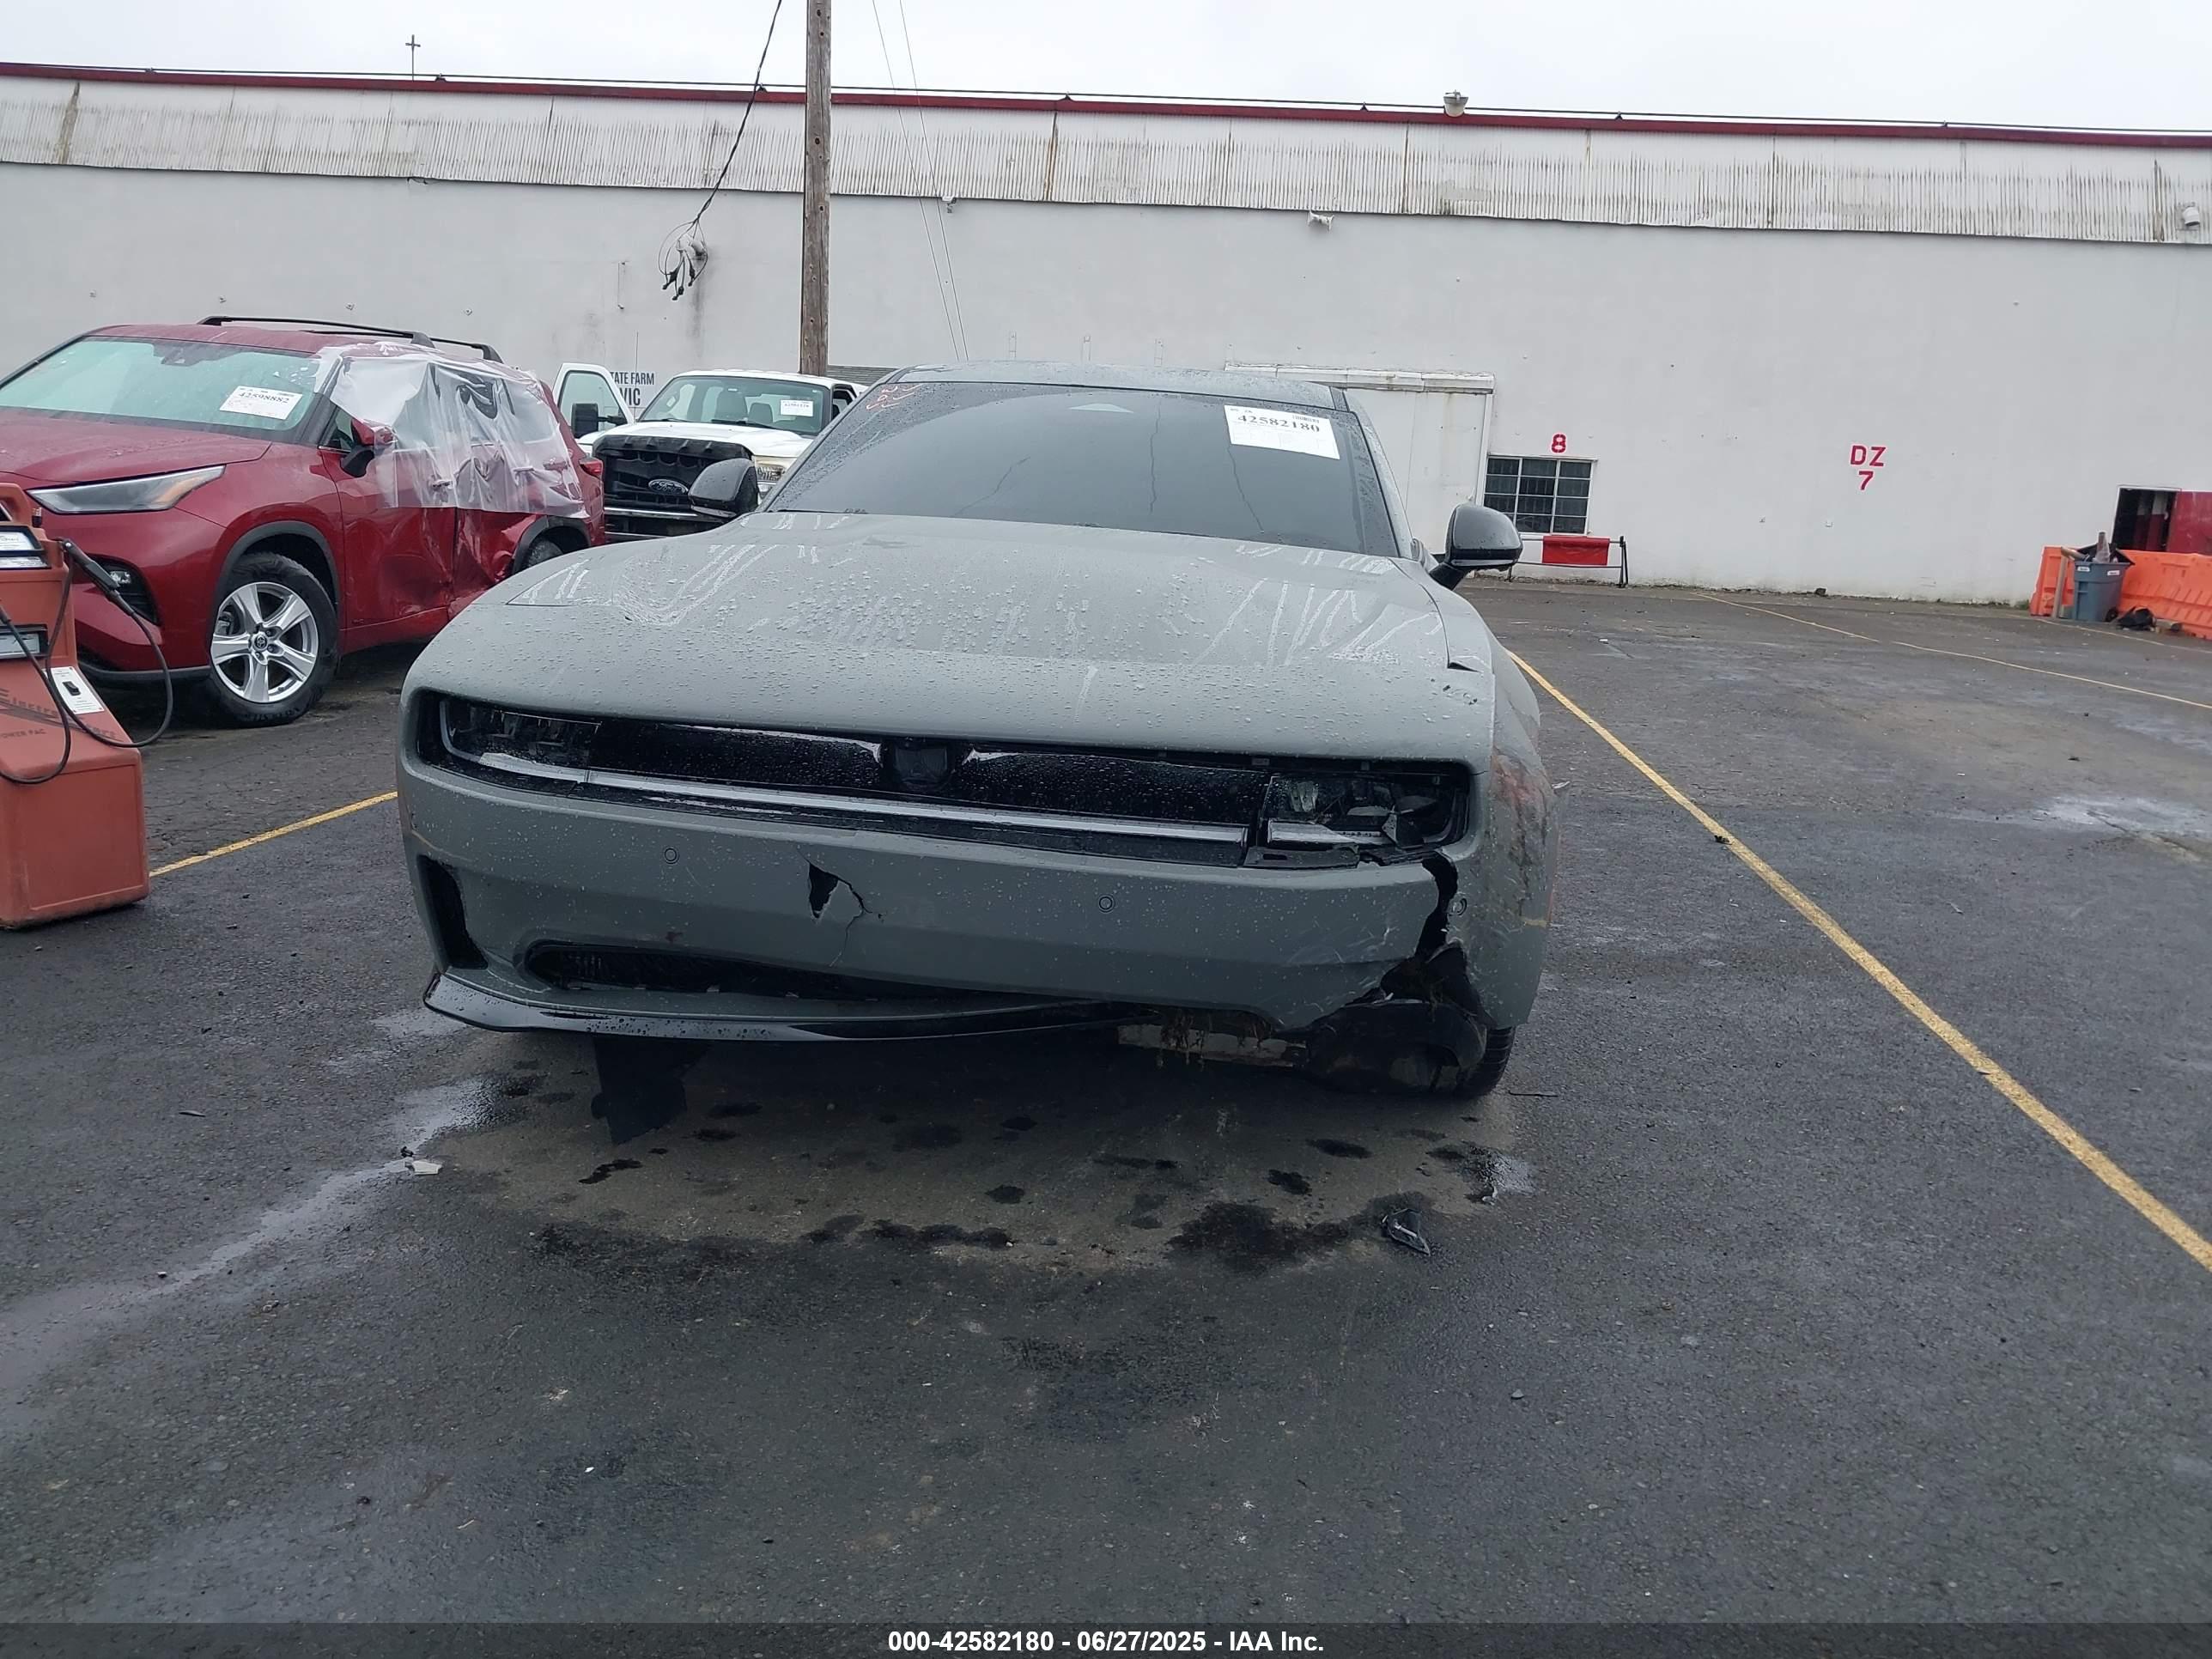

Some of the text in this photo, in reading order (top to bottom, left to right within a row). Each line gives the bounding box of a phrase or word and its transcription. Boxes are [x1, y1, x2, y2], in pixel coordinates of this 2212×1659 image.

[611, 372, 654, 386] TATE FARM
[1237, 415, 1320, 432] 42582180
[1551, 433, 1567, 453] 8
[1850, 445, 1887, 466] DZ
[1858, 471, 1874, 490] 7
